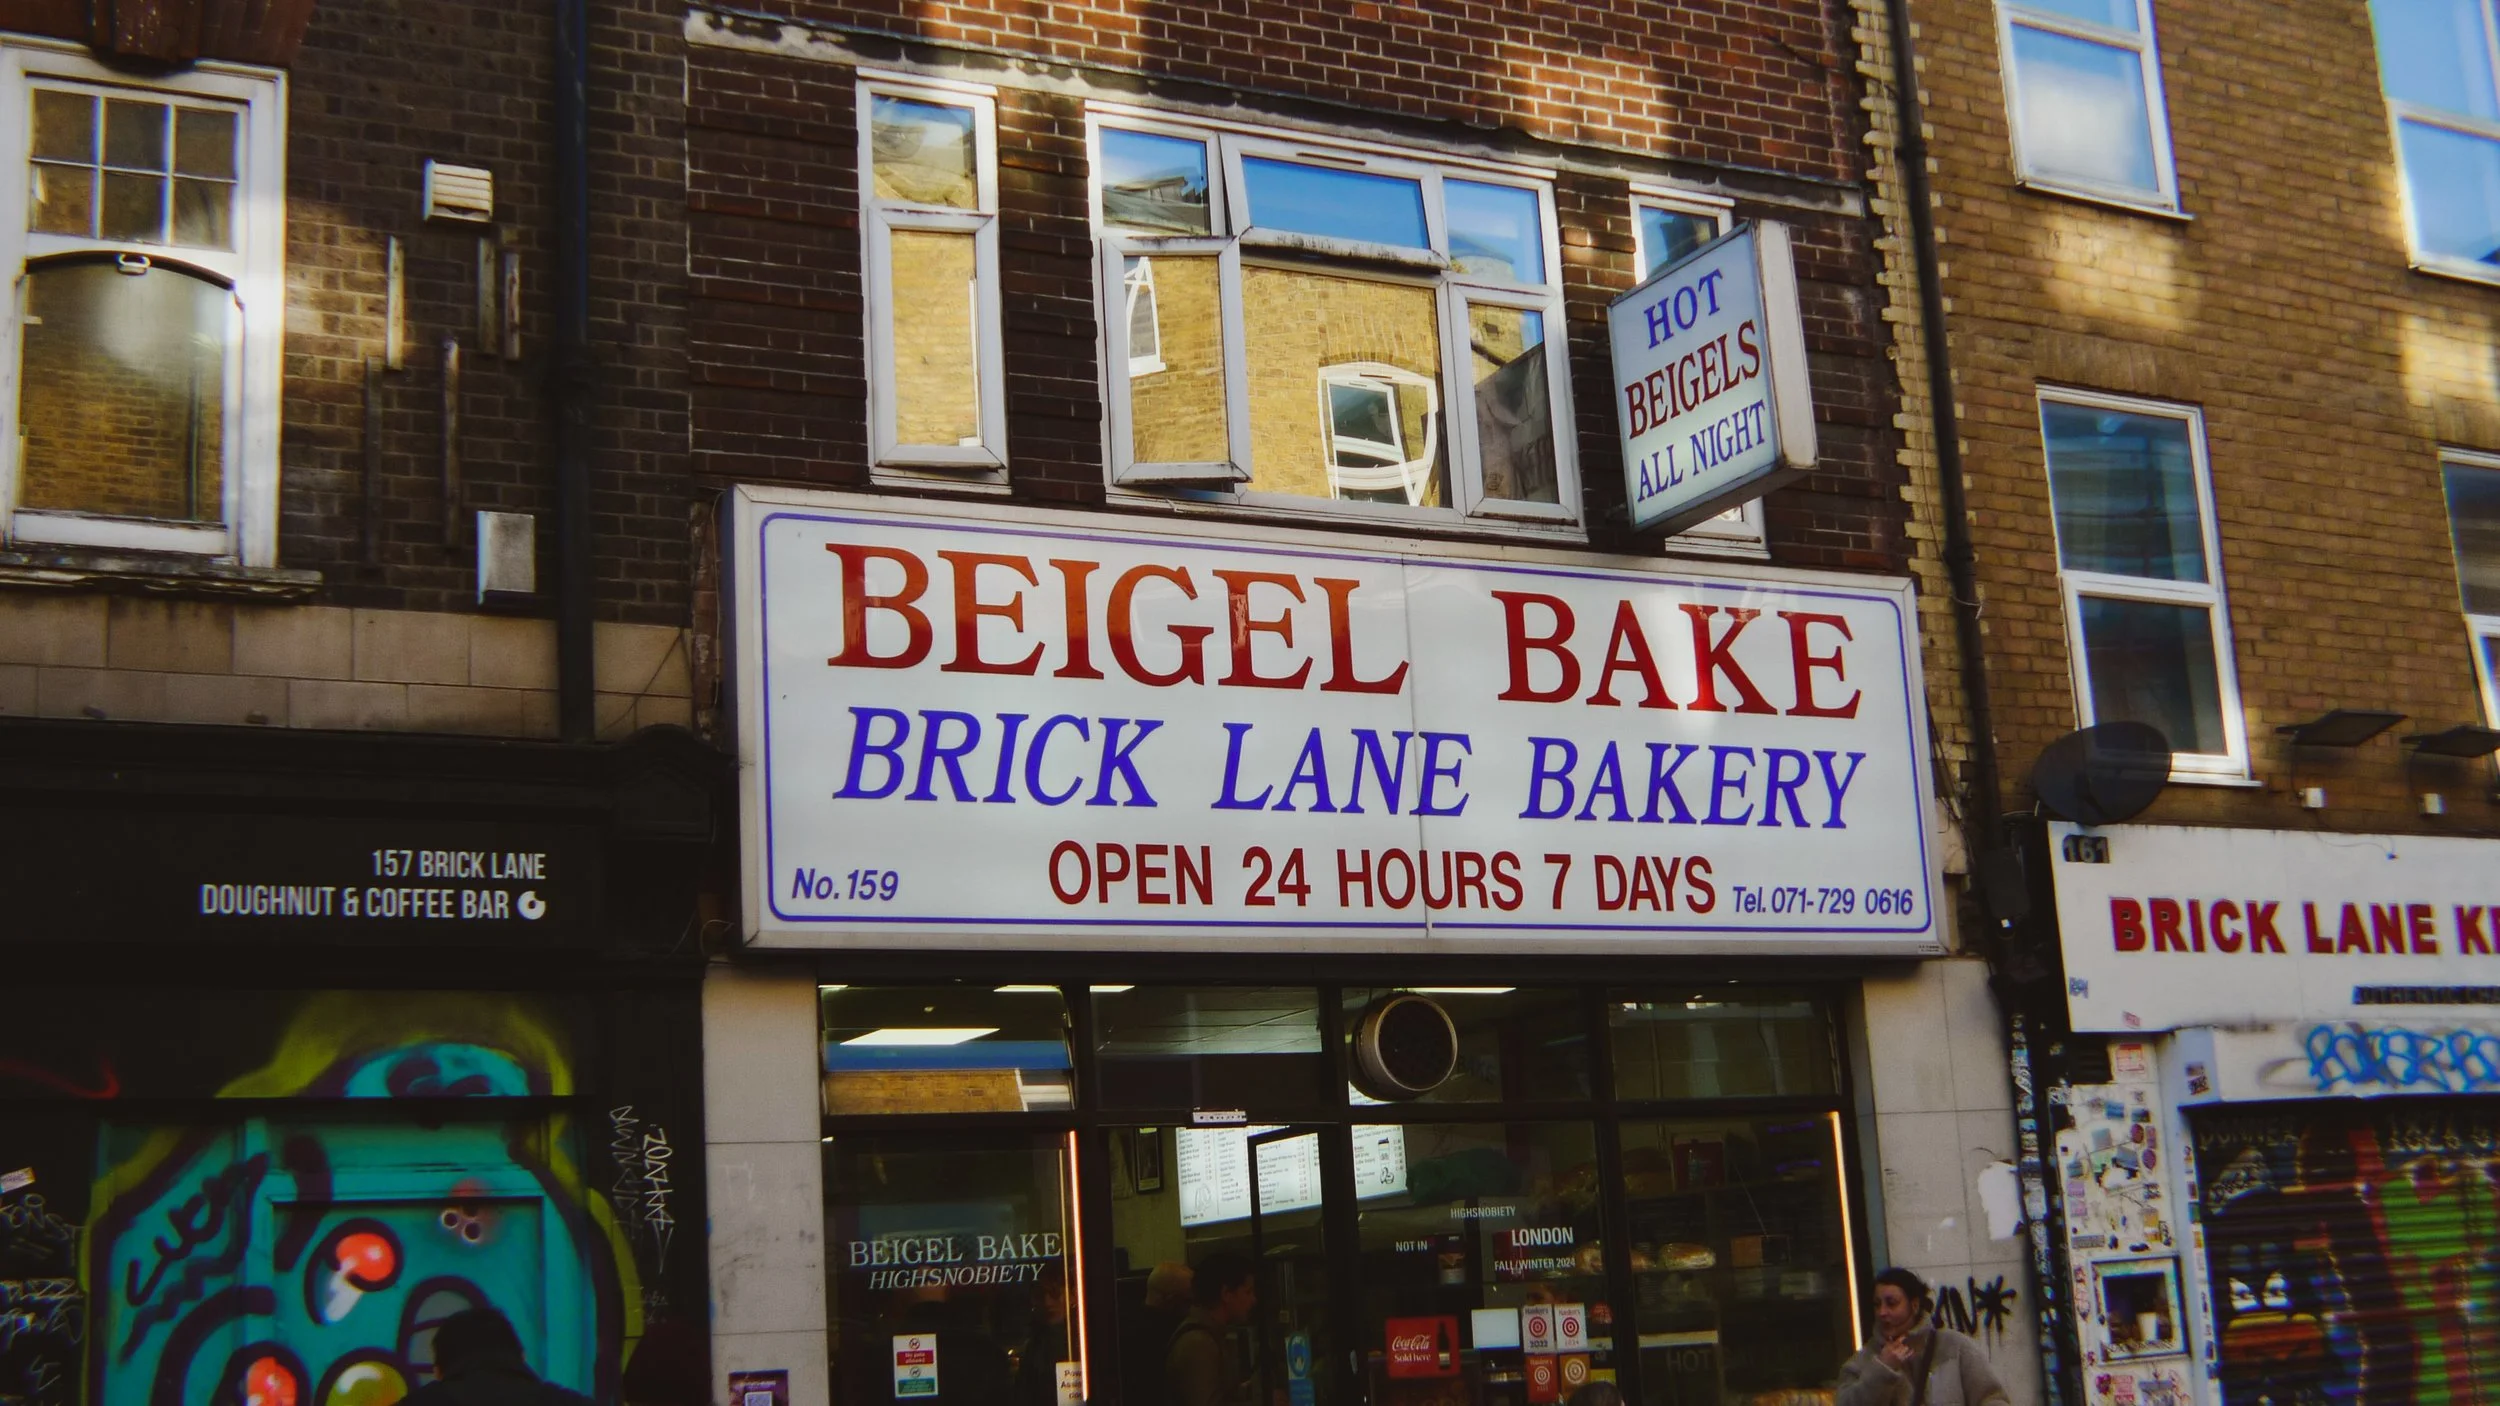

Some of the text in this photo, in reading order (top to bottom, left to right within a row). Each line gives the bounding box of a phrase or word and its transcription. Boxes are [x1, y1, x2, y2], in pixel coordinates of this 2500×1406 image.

[1644, 268, 1723, 349] HOT
[1625, 319, 1761, 440] BEIGELS
[1638, 399, 1766, 502] ALL NIGHT
[825, 543, 1862, 719] BEIGEL BAKE
[832, 706, 1866, 829] BRICK LANE BAKERY
[372, 850, 546, 880] 157 BRICK LANE
[1049, 840, 1717, 914] OPEN 24 HOURS 7 DAYS
[201, 884, 510, 919] DOUGHNUT & COFFEE BAR
[1865, 888, 1914, 916] 0616
[2109, 896, 2287, 955] BRICK
[2302, 900, 2441, 956] LANE
[1450, 1206, 1516, 1219] HIGHSNOBIETY
[848, 1233, 1062, 1268] BEIGEL BAKE
[1395, 1240, 1428, 1252] NOT IN
[1511, 1227, 1574, 1247] LONDON
[869, 1263, 1045, 1290] HIGHSNOBIETY
[1494, 1258, 1575, 1272] FALL/WINTER 2024
[1394, 1353, 1411, 1363] Sold
